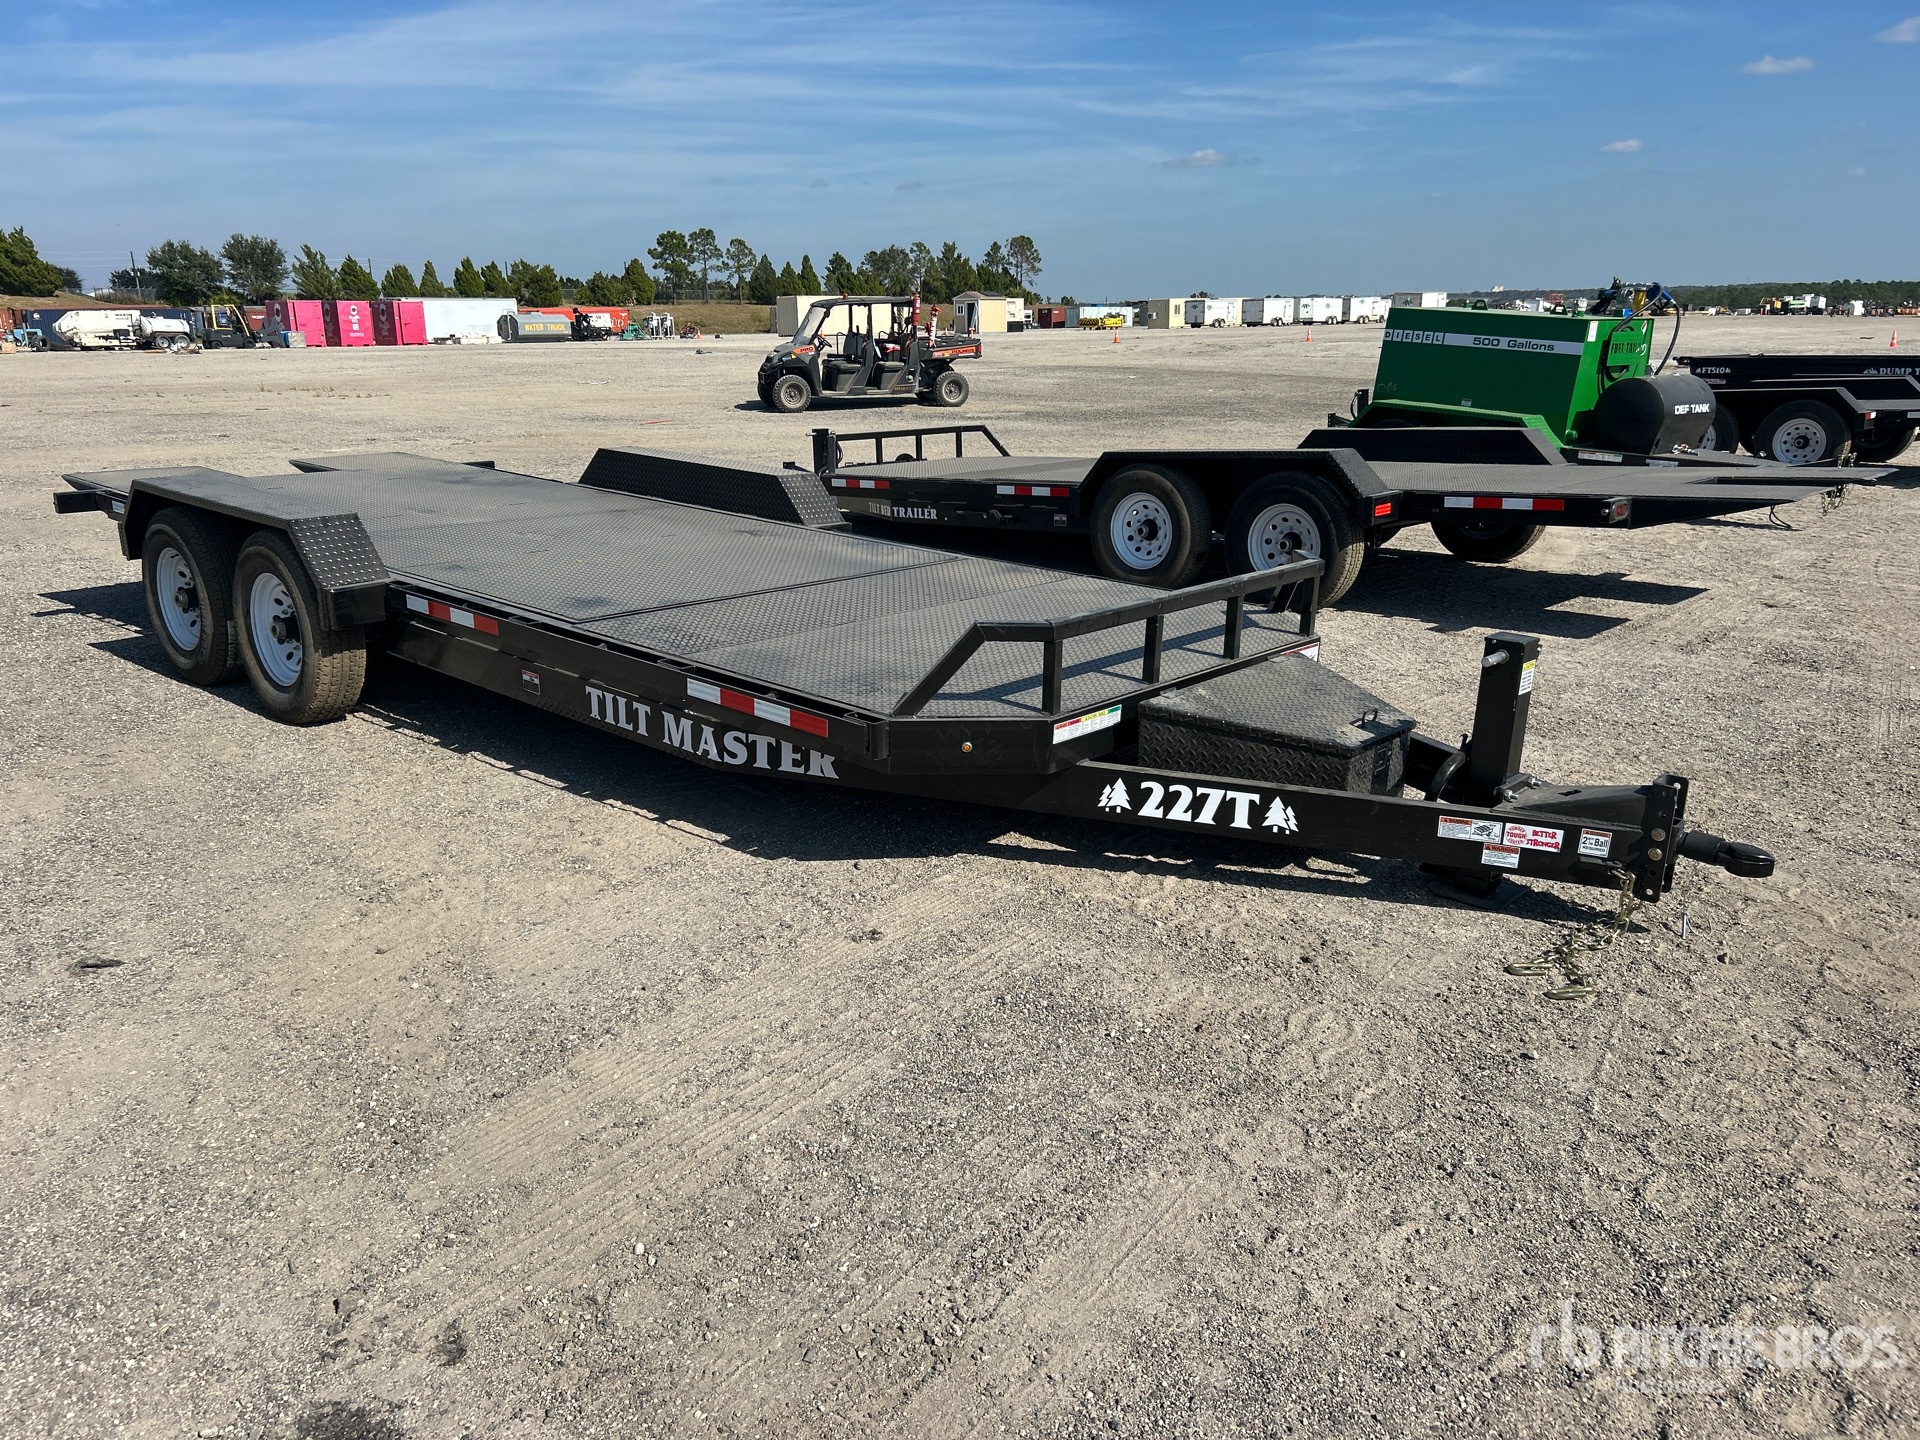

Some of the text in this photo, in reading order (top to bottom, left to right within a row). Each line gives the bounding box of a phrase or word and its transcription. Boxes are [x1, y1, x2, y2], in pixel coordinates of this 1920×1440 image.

[524, 323, 544, 332] WATER
[1384, 332, 1554, 352] DIESEL 500 Gallons
[1674, 403, 1710, 414] DEF TANK
[868, 502, 938, 520] TILT BED TRAILER
[585, 686, 840, 780] TILT MASTER
[1137, 781, 1260, 830] 227T
[1532, 830, 1557, 840] BETTER
[1526, 838, 1560, 850] STRONGER
[1594, 838, 1609, 848] Ball
[1492, 845, 1518, 854] WARNING
